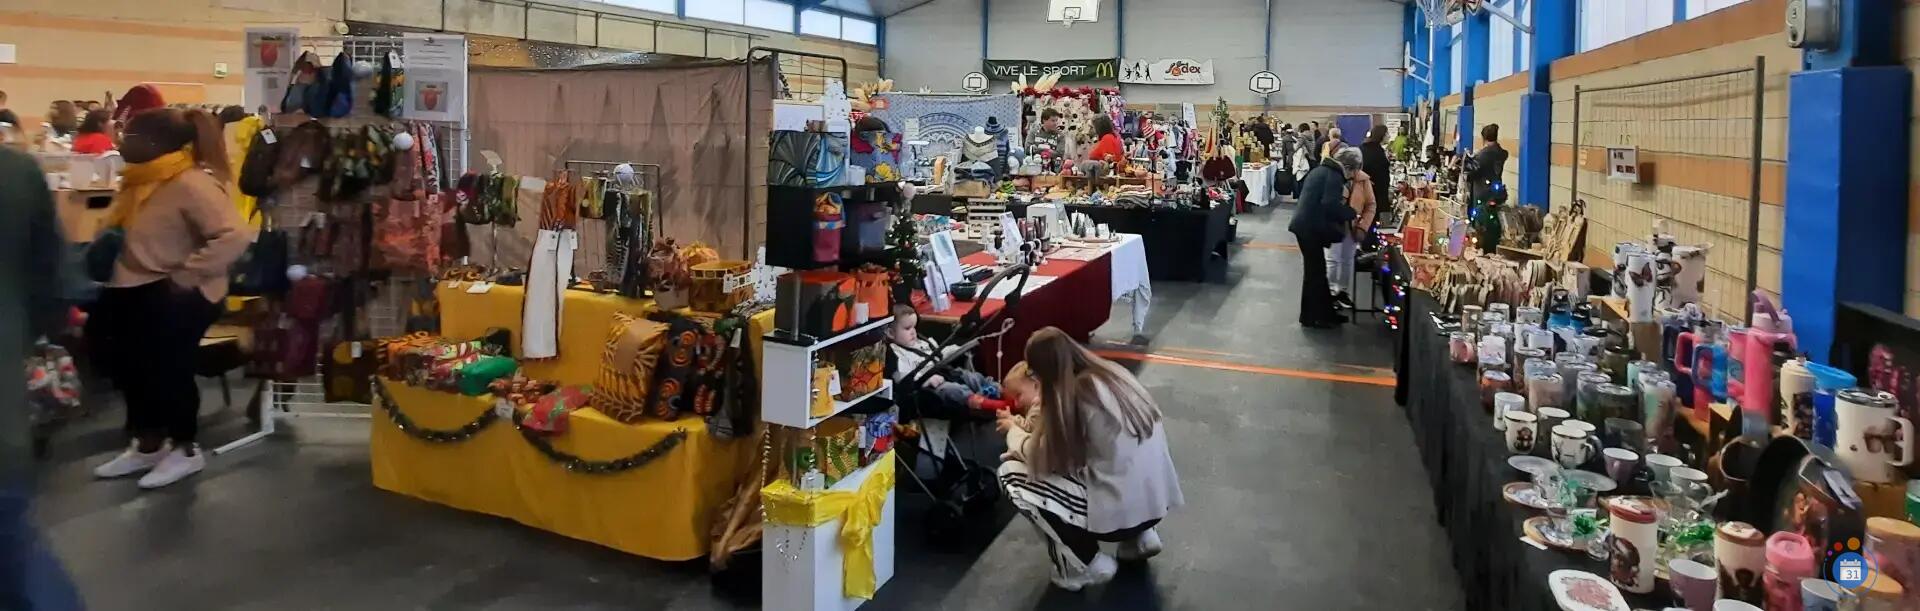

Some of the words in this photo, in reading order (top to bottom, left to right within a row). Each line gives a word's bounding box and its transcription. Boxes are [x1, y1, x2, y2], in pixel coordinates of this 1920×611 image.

[992, 65, 1019, 75] VIVE
[1023, 65, 1038, 75] LE
[1043, 65, 1087, 76] SPORT
